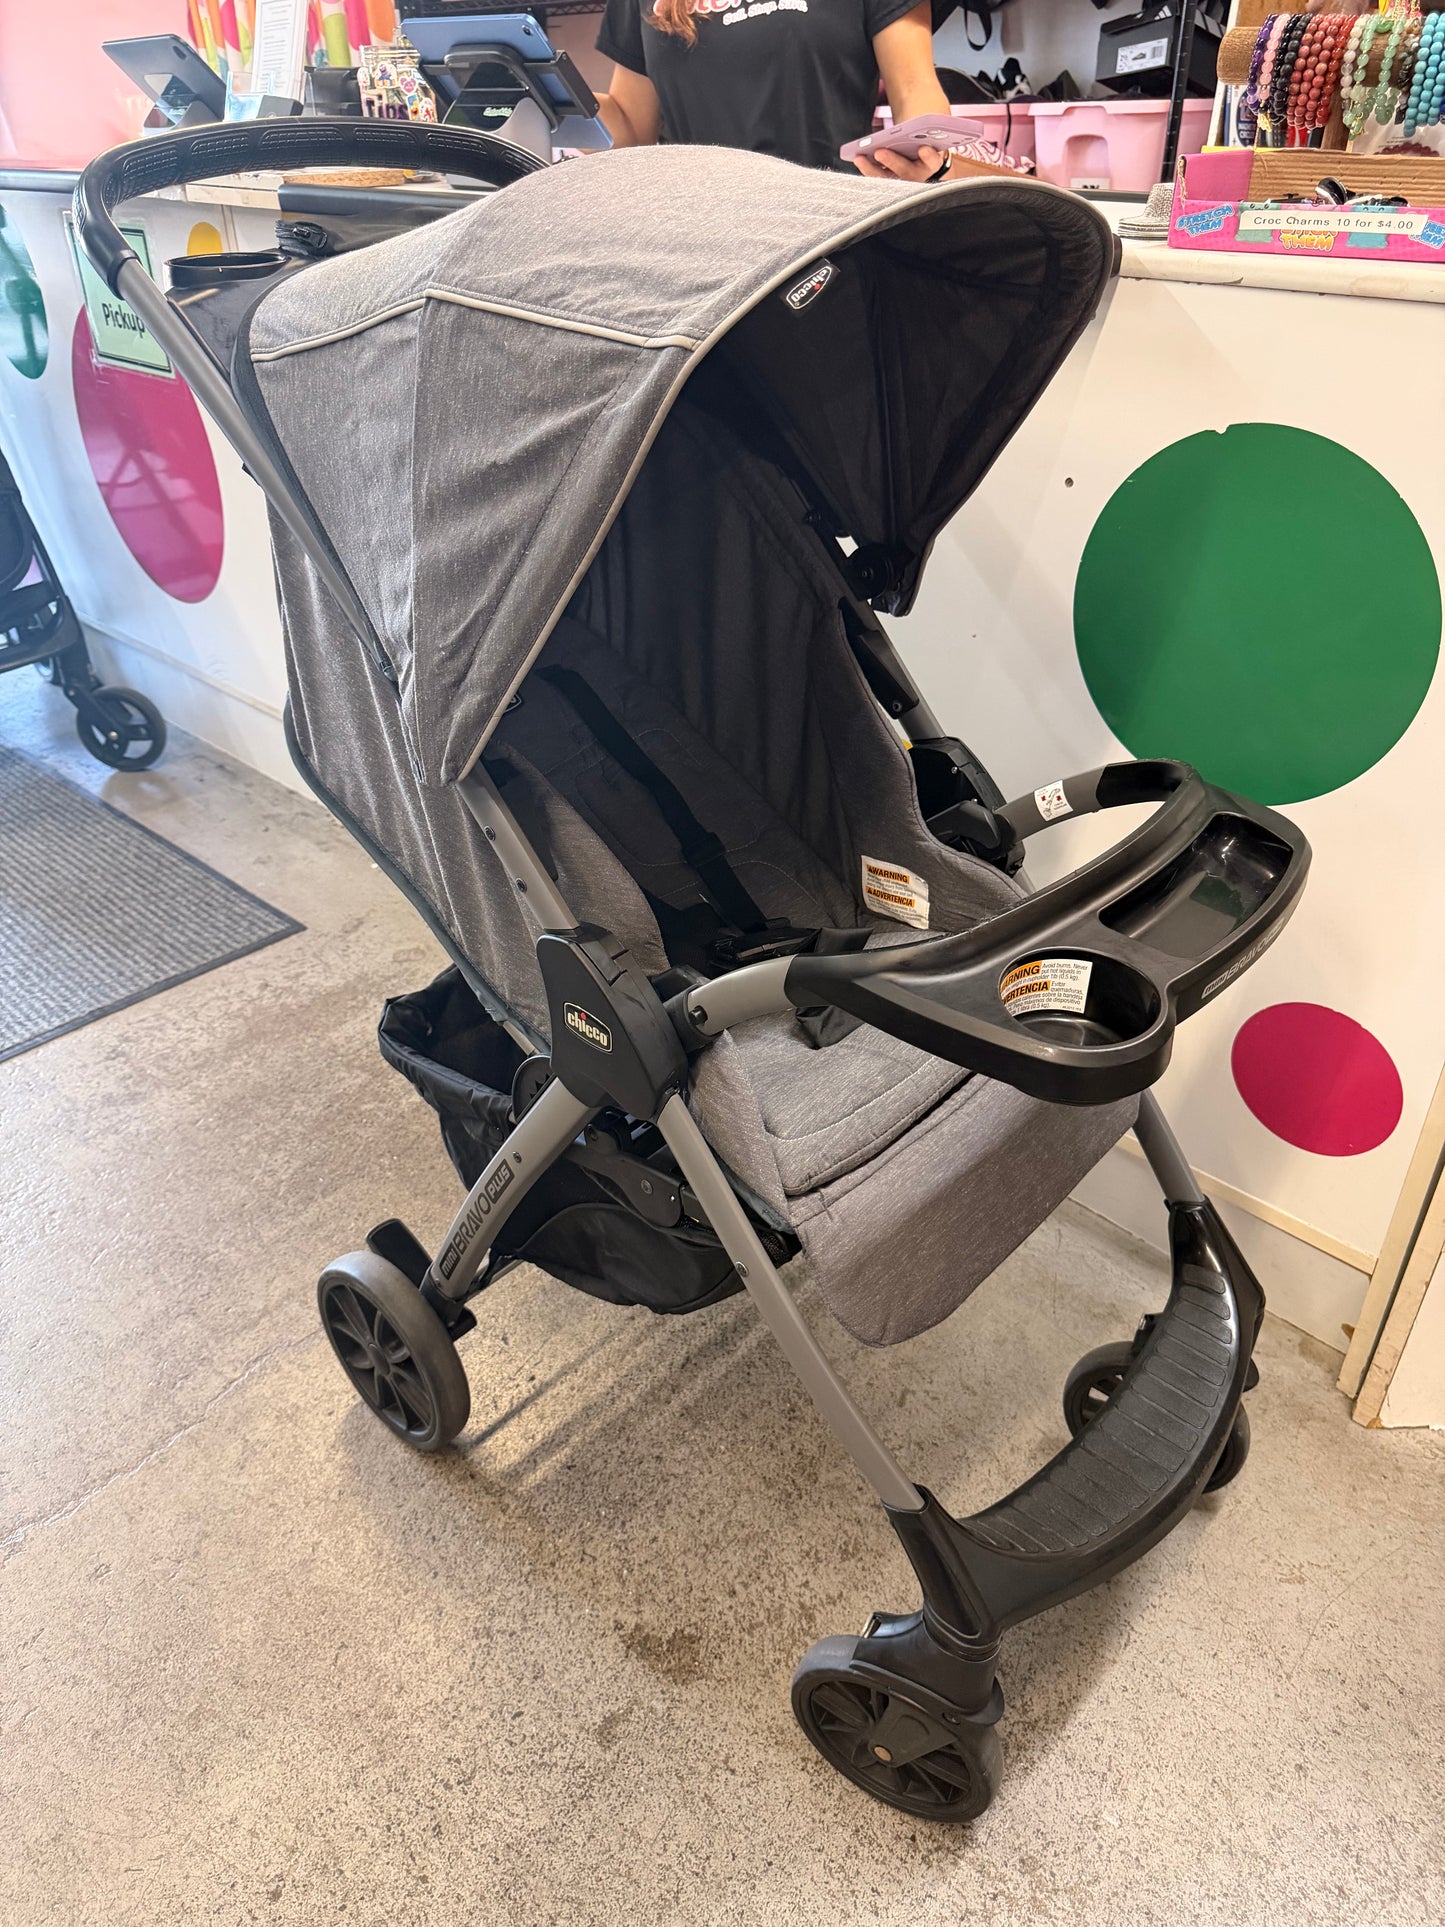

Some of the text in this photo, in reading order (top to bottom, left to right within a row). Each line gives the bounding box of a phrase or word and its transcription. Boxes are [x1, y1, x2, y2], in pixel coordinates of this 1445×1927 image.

[1176, 204, 1234, 228] STRETCH
[1187, 218, 1223, 235] THEM
[1254, 216, 1282, 225] Croc
[1286, 216, 1330, 227] Charms
[1337, 218, 1351, 227] 10
[1355, 218, 1372, 228] for
[1377, 220, 1414, 230] $4.00
[1280, 233, 1334, 251] THEM
[791, 269, 828, 303] chicco
[101, 302, 146, 339] Pickup
[872, 866, 908, 883] WARNING
[872, 887, 913, 907] ADVERTENCIA
[567, 1011, 608, 1047] chicco
[452, 1192, 492, 1256] BRAVO
[486, 1163, 510, 1199] PLUS
